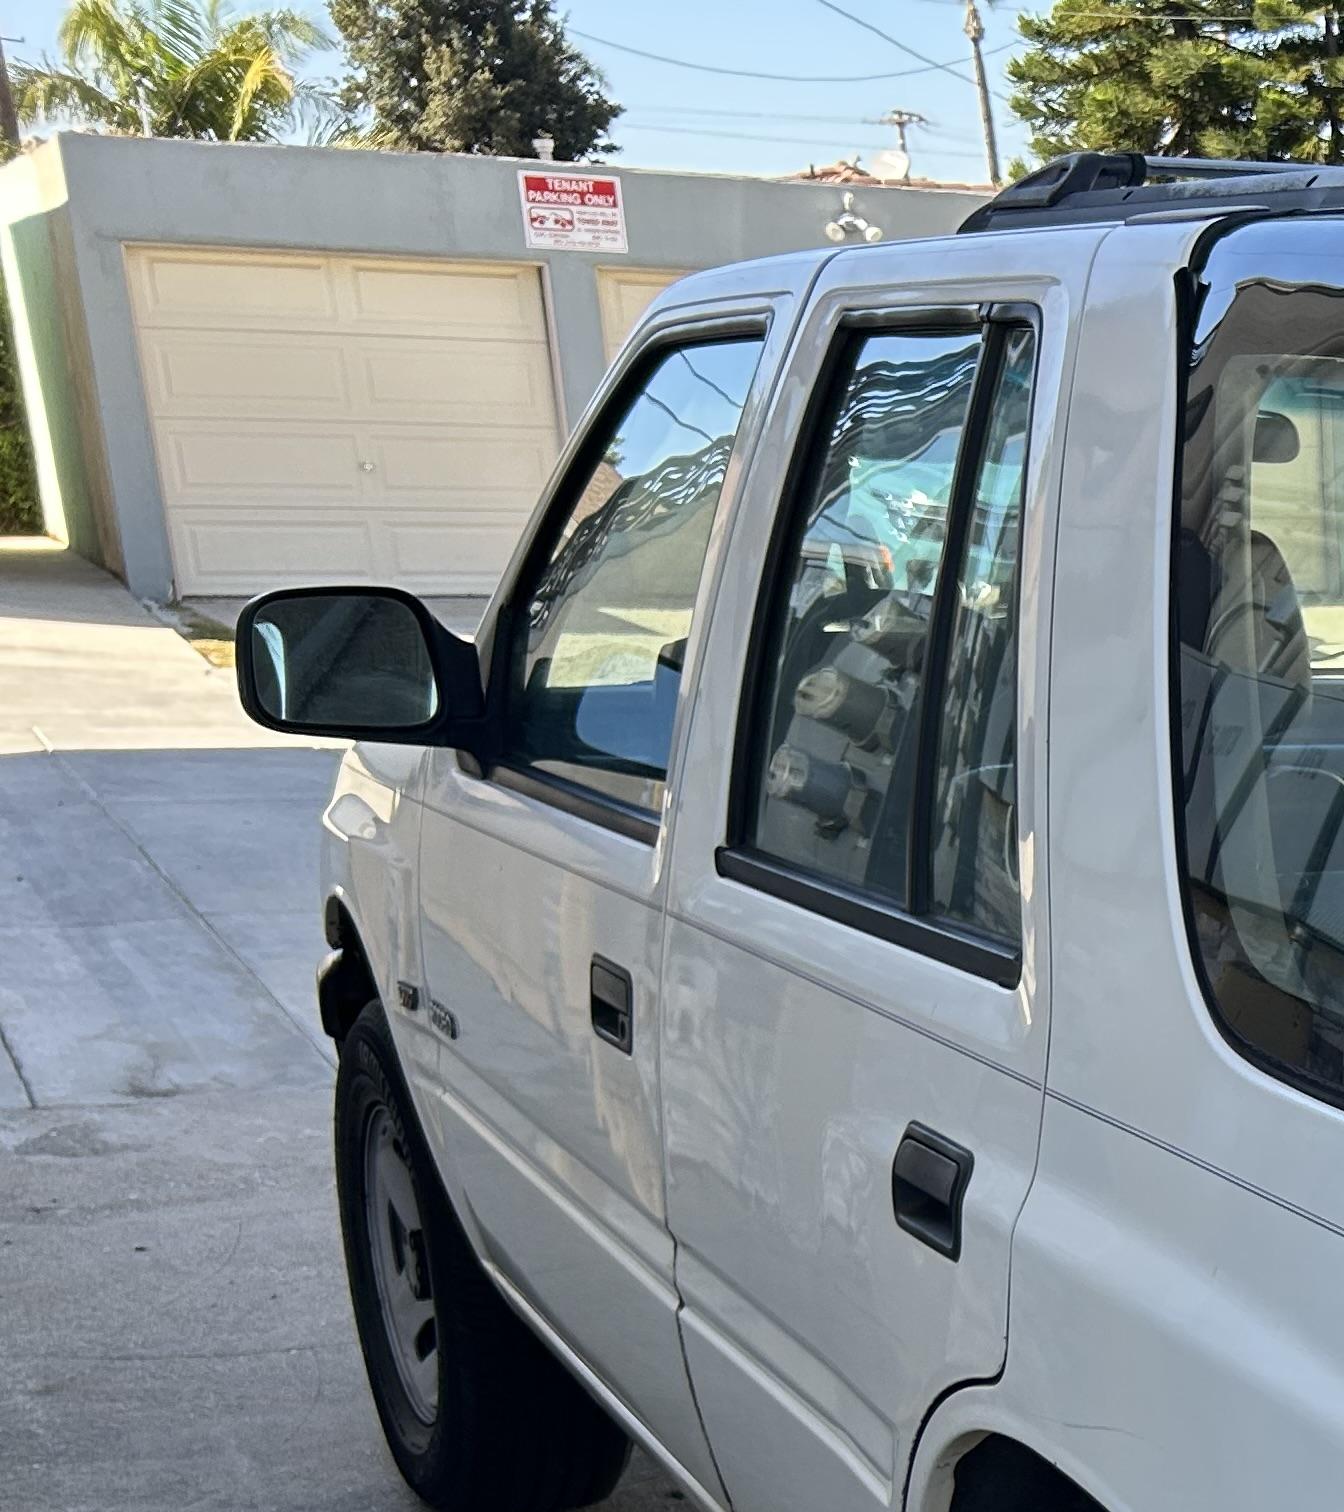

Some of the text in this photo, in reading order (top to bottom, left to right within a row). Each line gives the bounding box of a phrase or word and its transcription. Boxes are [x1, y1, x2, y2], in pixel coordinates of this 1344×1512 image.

[545, 178, 595, 192] TENANT
[528, 190, 615, 206] PARKING ONLY
